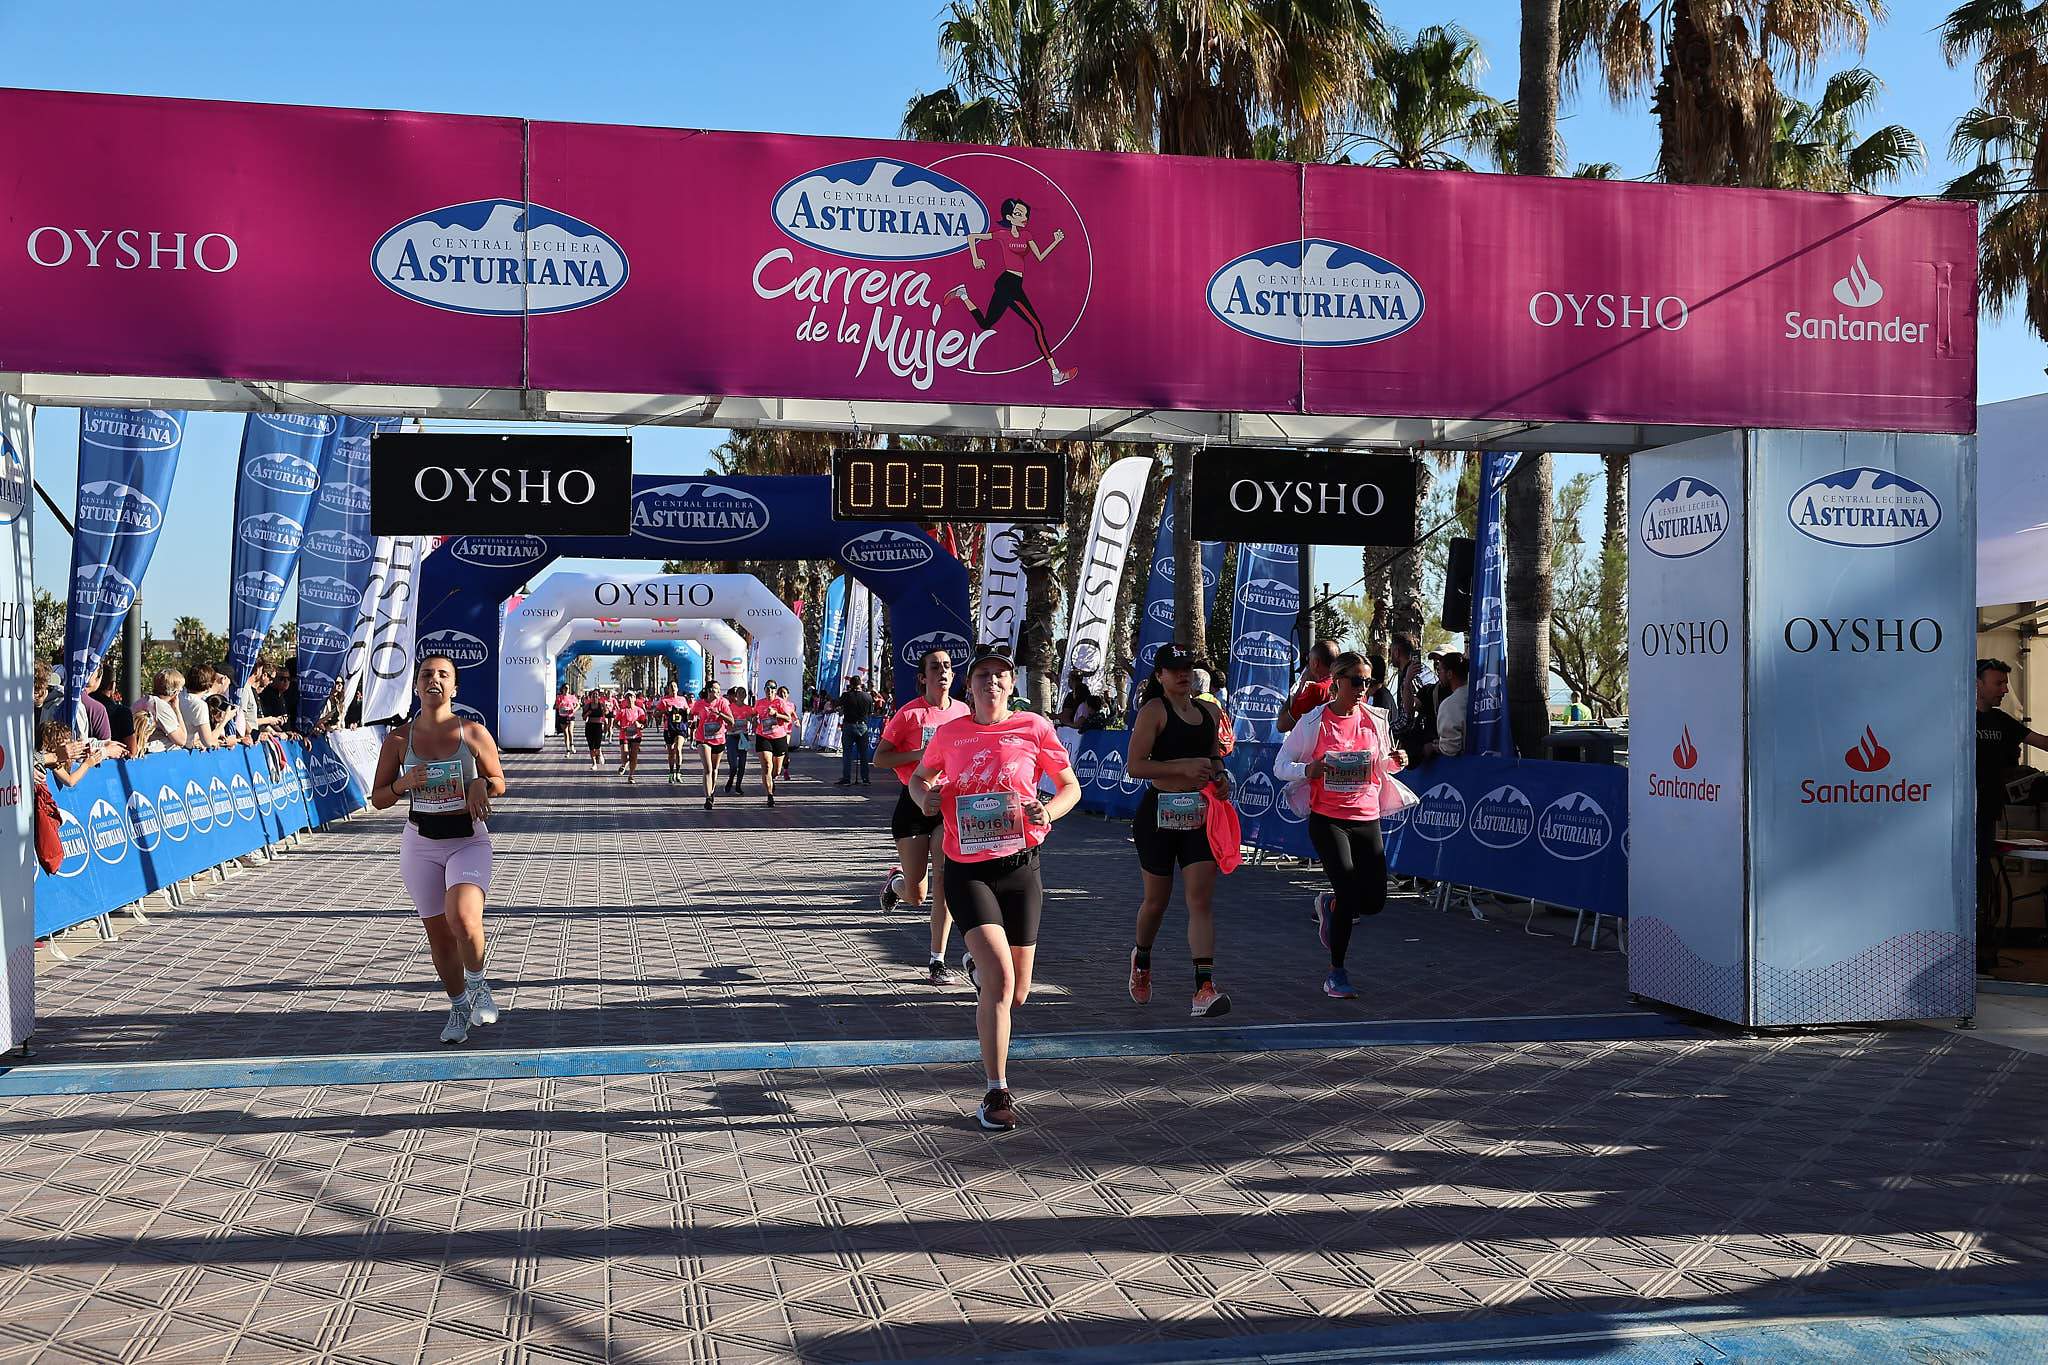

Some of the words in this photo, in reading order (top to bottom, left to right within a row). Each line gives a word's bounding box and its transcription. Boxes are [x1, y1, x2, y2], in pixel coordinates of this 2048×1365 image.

[823, 190, 890, 203] CENTRAL
[898, 194, 967, 208] LECHERA
[789, 191, 971, 237] ASTURIANA
[27, 226, 239, 274] OYSHO
[432, 237, 512, 251] CENTRAL
[521, 240, 601, 254] LECHERA
[391, 238, 610, 287] ASTURIANA
[752, 247, 932, 307] Carrera
[1257, 274, 1325, 286] CENTRAL
[1333, 277, 1401, 289] LECHERA
[1223, 275, 1408, 321] ASTURIANA
[1529, 291, 1690, 332] OYSHO
[1785, 311, 1930, 345] Santander
[796, 305, 830, 342] de
[837, 306, 861, 344] la
[855, 303, 998, 391] Mujer
[252, 462, 315, 489] ASTURIAN
[414, 466, 596, 505] OYSHO
[850, 461, 1047, 511] 00:37:30
[655, 500, 702, 508] CENTRAL
[706, 501, 754, 509] LECHERA
[1229, 479, 1385, 516] OYSHO
[1659, 506, 1686, 517] CENTRAL
[1688, 499, 1720, 511] LECHERA
[1823, 495, 1871, 503] CENTRAL
[1876, 496, 1925, 504] LECHERA
[79, 505, 152, 529] STURIANA
[632, 500, 759, 529] ASTURIANA
[1799, 496, 1930, 528] ASTURIANA
[243, 523, 300, 547] ASTURIAN
[1646, 511, 1723, 541] ASTURIANA
[306, 536, 366, 558] ASTURIANA
[456, 539, 540, 557] ASTURIANA
[849, 546, 928, 562] ASTURIANA
[299, 583, 357, 604] ASTURIANA
[594, 583, 714, 607] OYSHO
[1071, 490, 1132, 677] OYSHO
[371, 539, 413, 680] OYSH
[522, 608, 559, 617] OYSHO
[747, 608, 782, 617] OYSHO
[300, 636, 346, 650] STURIANA
[1642, 619, 1729, 657] OYSHO
[1784, 617, 1943, 653] OYSHO
[505, 656, 540, 665] OYSHO
[766, 657, 798, 665] OYSHO
[504, 704, 539, 713] OYSHO
[1977, 729, 2002, 741] YSHO
[1649, 773, 1721, 802] Santander
[1800, 778, 1932, 804] Santander
[1415, 802, 1460, 828] ASTURIANA
[1473, 806, 1528, 834] ASTURIANA
[1541, 814, 1602, 847] ASTURIANA
